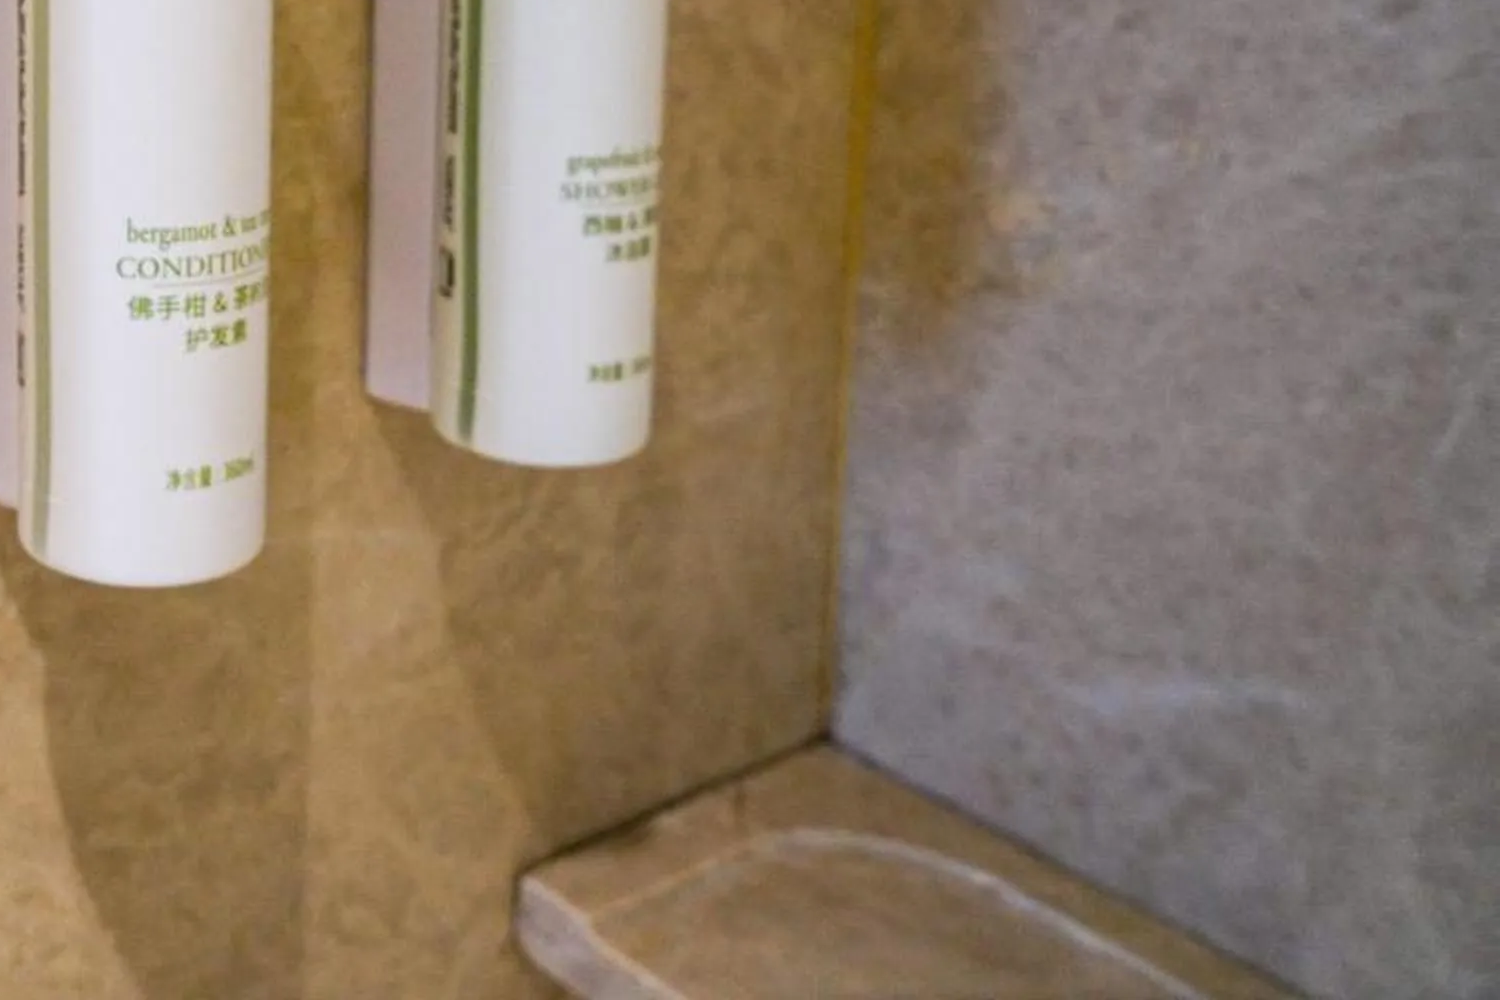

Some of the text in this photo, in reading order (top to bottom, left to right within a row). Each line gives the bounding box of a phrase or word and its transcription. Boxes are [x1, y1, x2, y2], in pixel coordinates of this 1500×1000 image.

[127, 217, 217, 251] bergamot
[128, 293, 206, 320] 佛手柑
